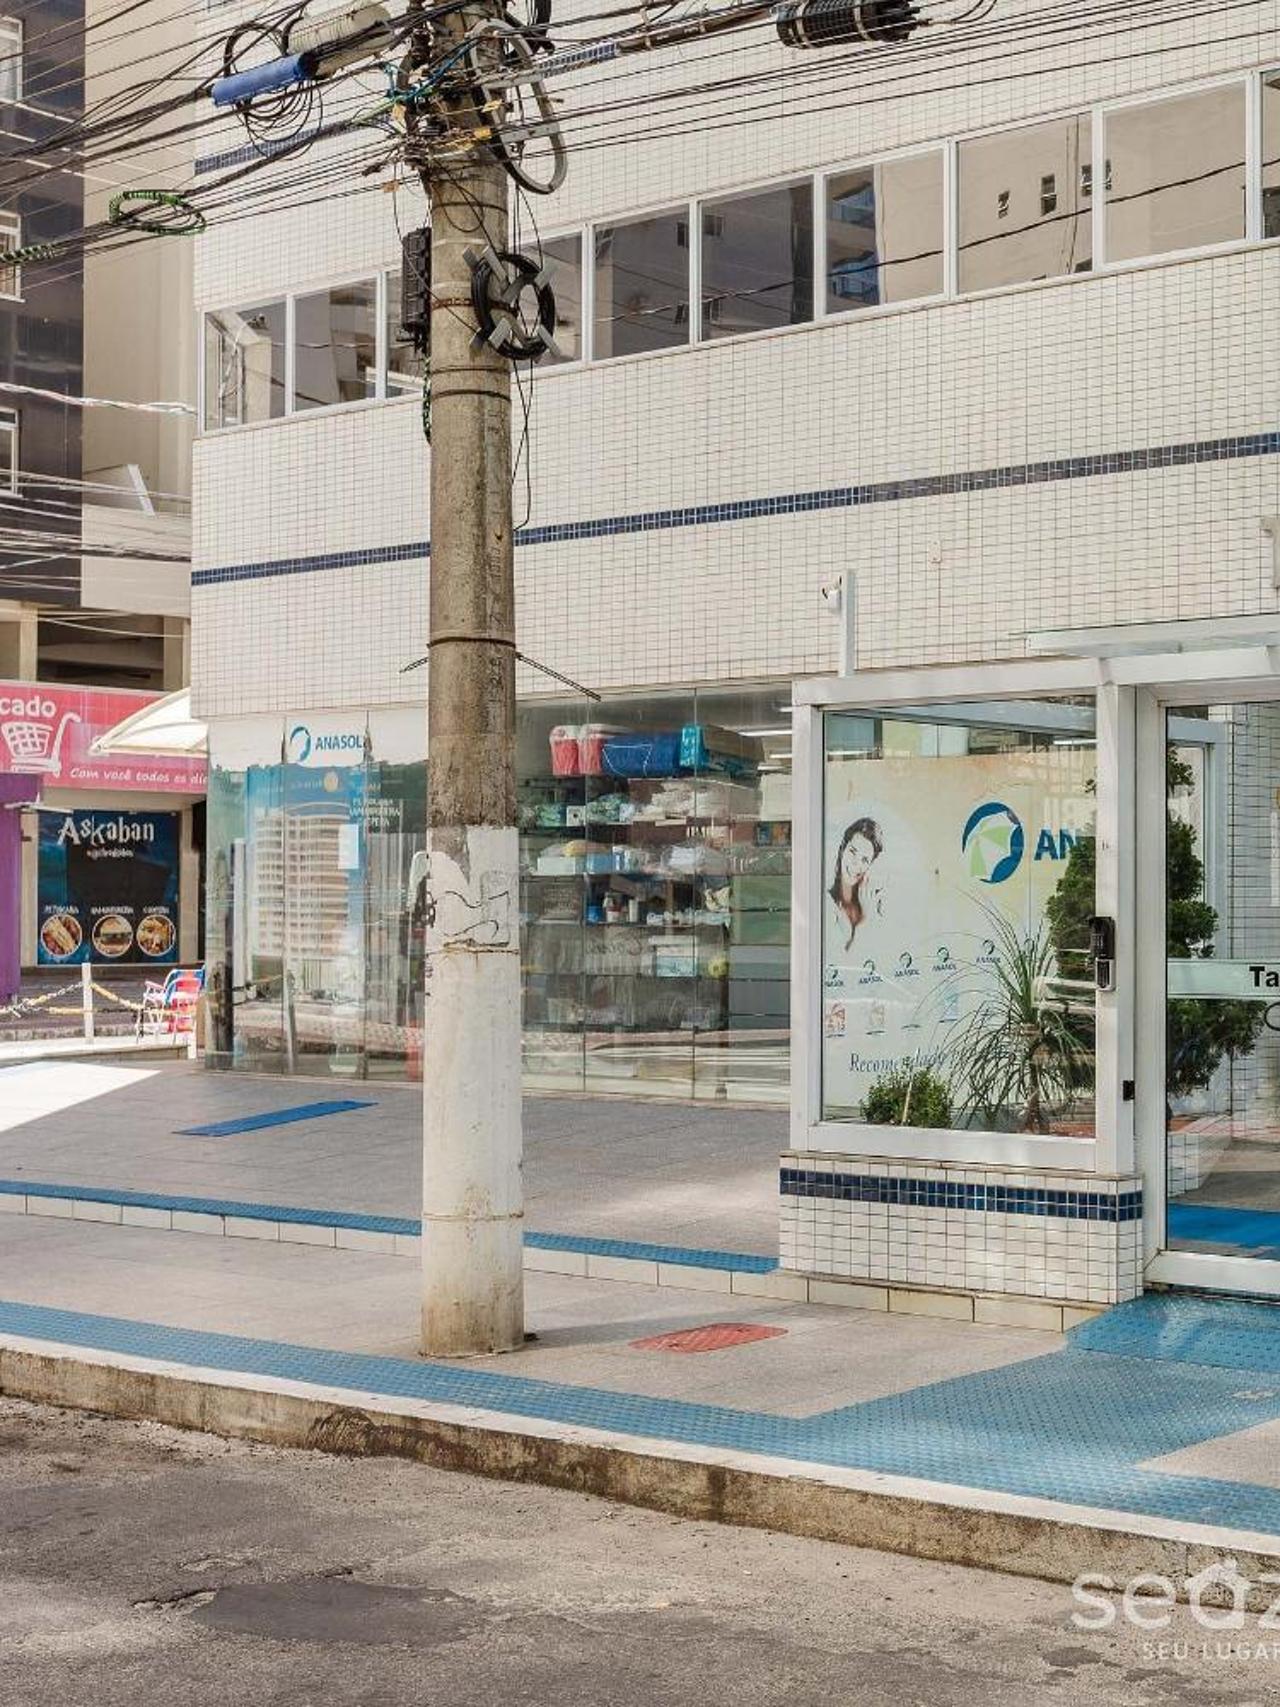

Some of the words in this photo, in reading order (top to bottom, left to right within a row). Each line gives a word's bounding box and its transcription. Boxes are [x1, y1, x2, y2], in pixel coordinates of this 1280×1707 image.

[0, 696, 57, 718] cado
[315, 735, 362, 750] ANASOL
[57, 815, 155, 847] Askaban
